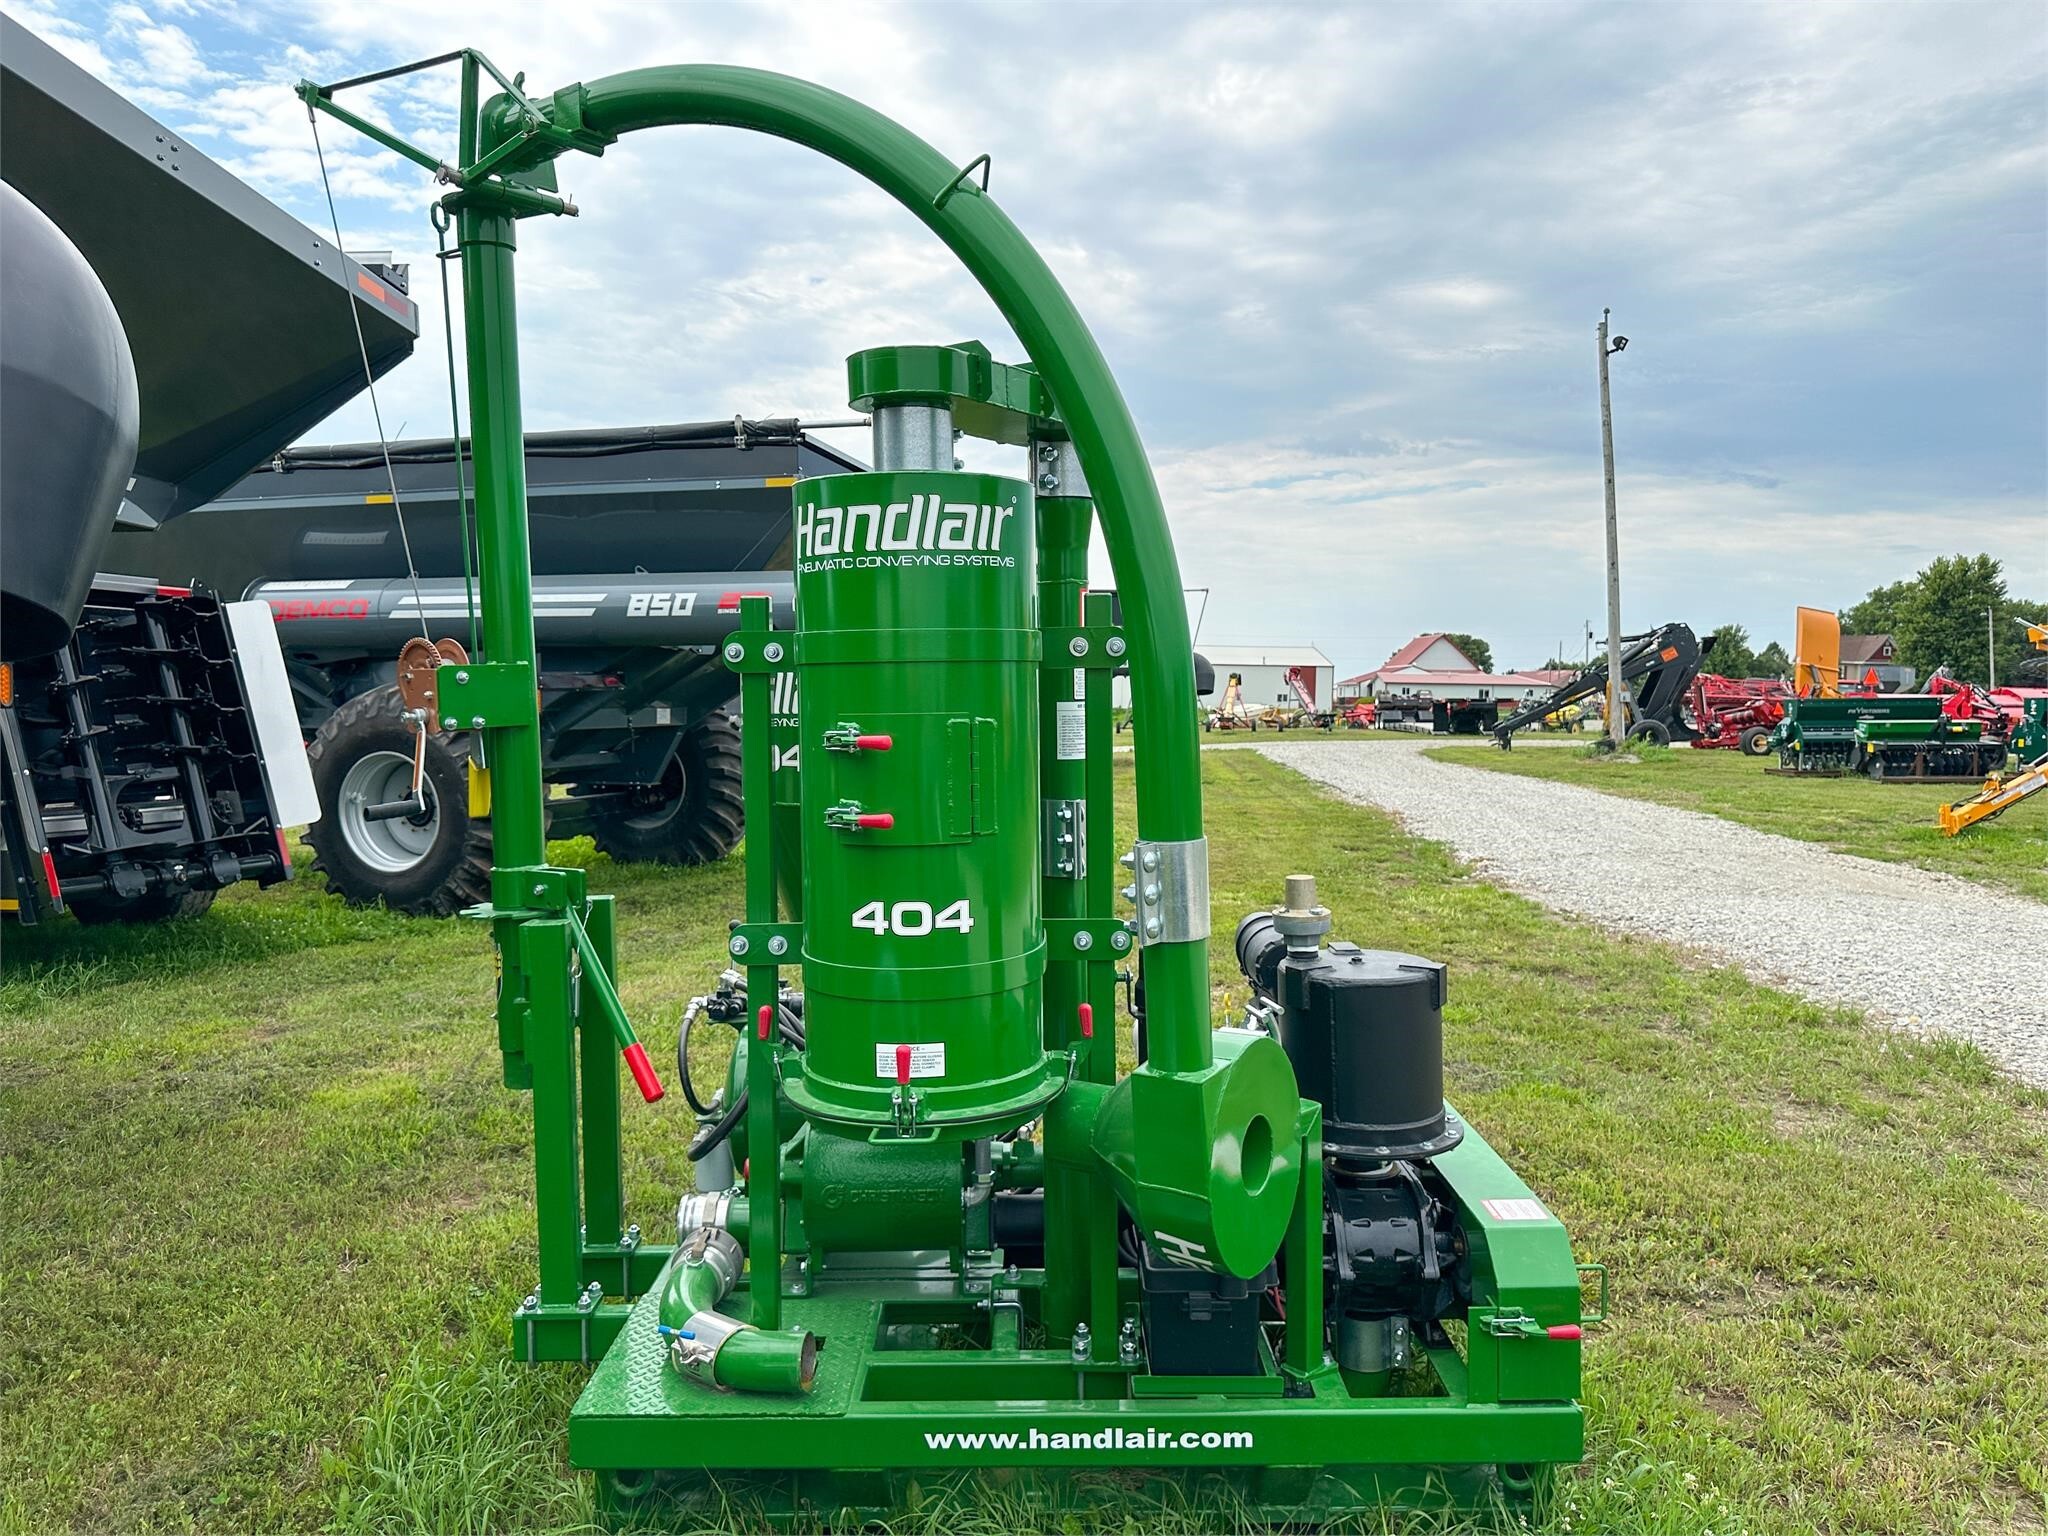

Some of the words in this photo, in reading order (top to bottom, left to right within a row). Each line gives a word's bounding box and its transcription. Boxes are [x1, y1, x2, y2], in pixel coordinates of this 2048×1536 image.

[797, 494, 1014, 558] Handlair
[855, 554, 951, 569] CONVEYING
[953, 554, 1015, 568] SYSTEMS
[269, 597, 369, 623] DEMCO
[626, 592, 698, 617] 850
[851, 899, 975, 936] 404
[924, 1428, 1254, 1449] www.handlair.com
